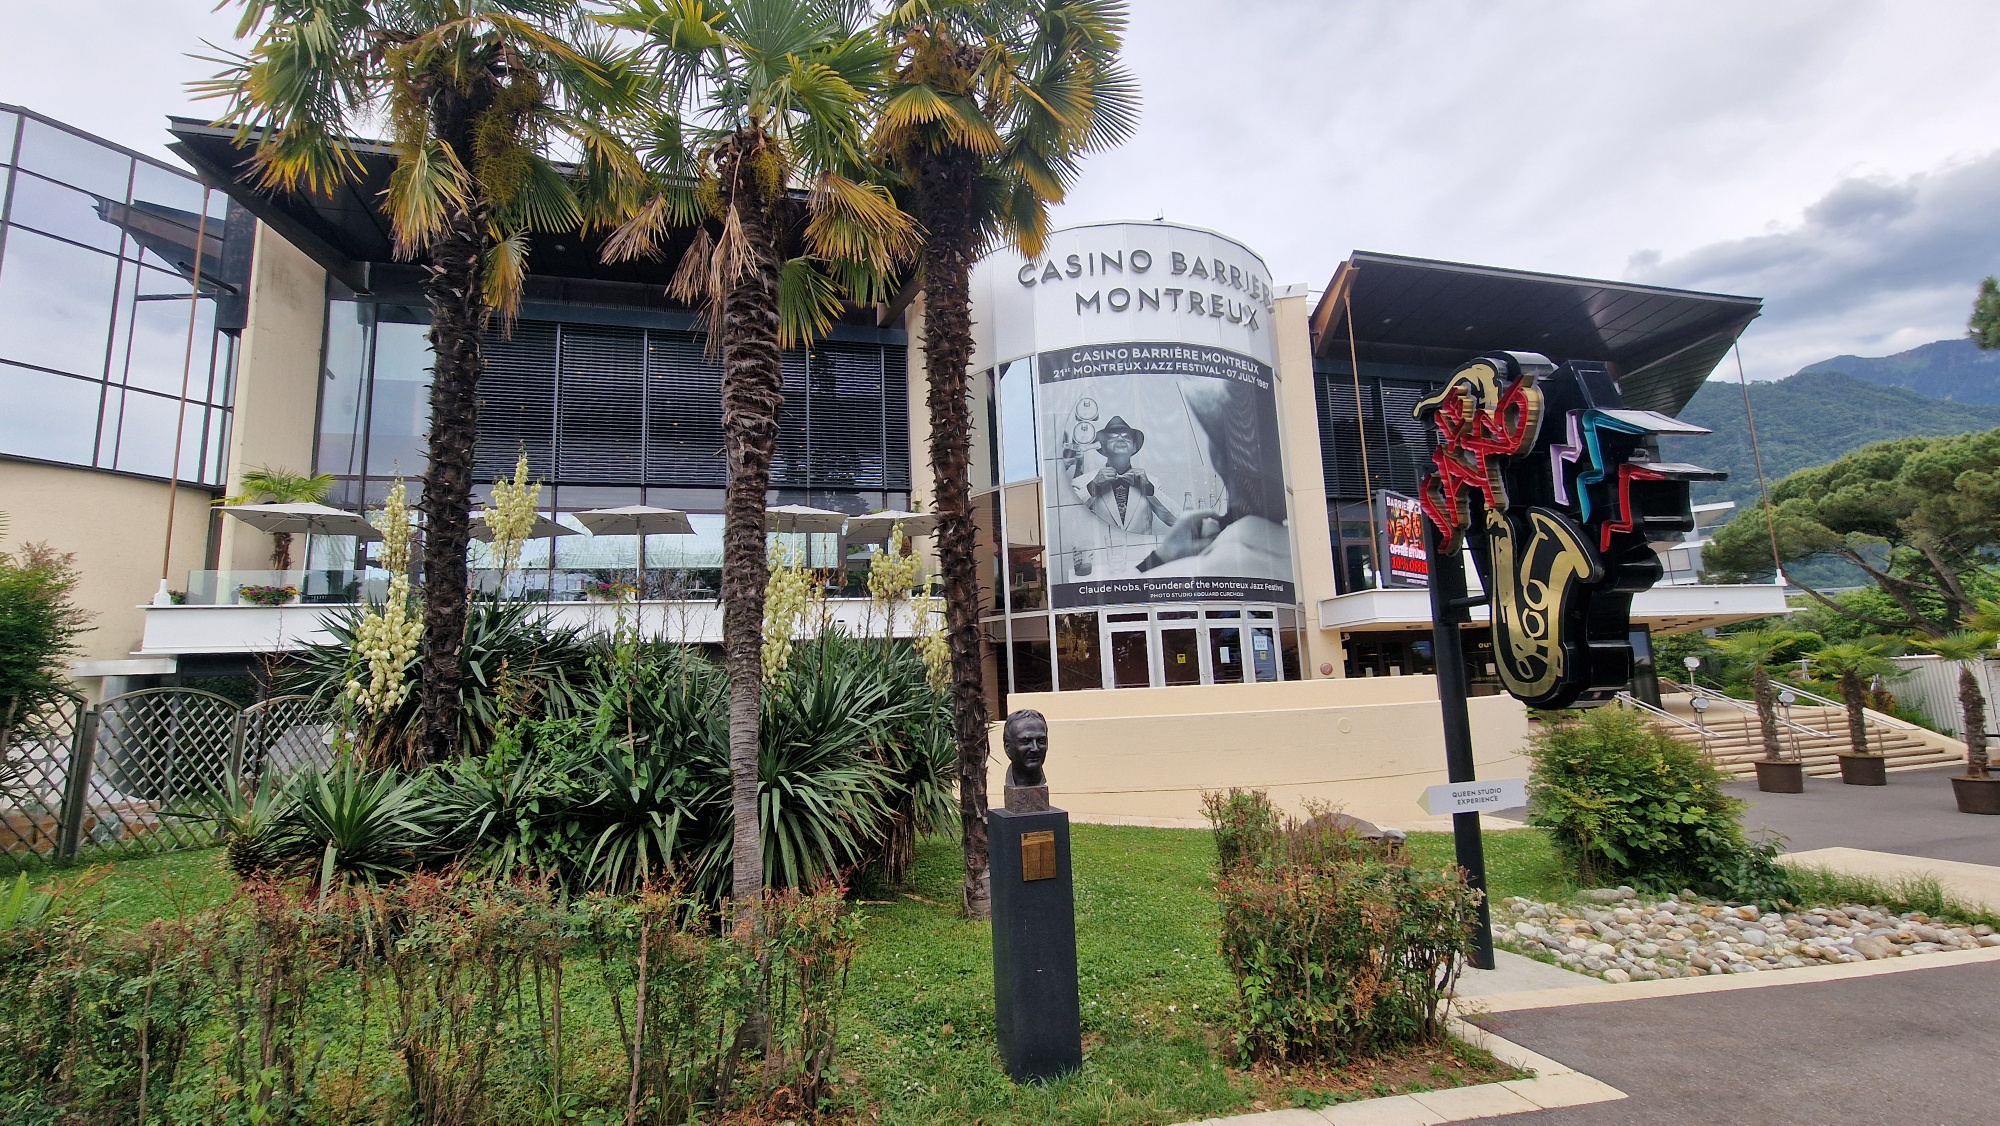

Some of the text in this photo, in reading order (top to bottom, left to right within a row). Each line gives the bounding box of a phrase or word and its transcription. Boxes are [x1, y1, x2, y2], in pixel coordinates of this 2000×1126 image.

[1018, 249, 1153, 288] CASINO
[1075, 287, 1260, 332] MONTREUX
[1053, 367, 1071, 379] 21st
[1073, 362, 1141, 375] MONTREUX
[1144, 362, 1173, 370] JAZZ
[1176, 362, 1221, 375] FESTIVAL
[1226, 368, 1237, 379] 07
[1238, 372, 1256, 384] JULY
[1072, 348, 1129, 363] CASINO
[1201, 351, 1260, 375] MONTREUX
[1079, 584, 1112, 595] Claude
[1113, 583, 1141, 592] Nobs,
[1143, 581, 1183, 591] Founder
[1184, 580, 1195, 589] of
[1196, 580, 1210, 589] the
[1211, 581, 1249, 590] Montreux
[1264, 583, 1284, 592] Festival
[1457, 796, 1499, 805] EXPERIENCE
